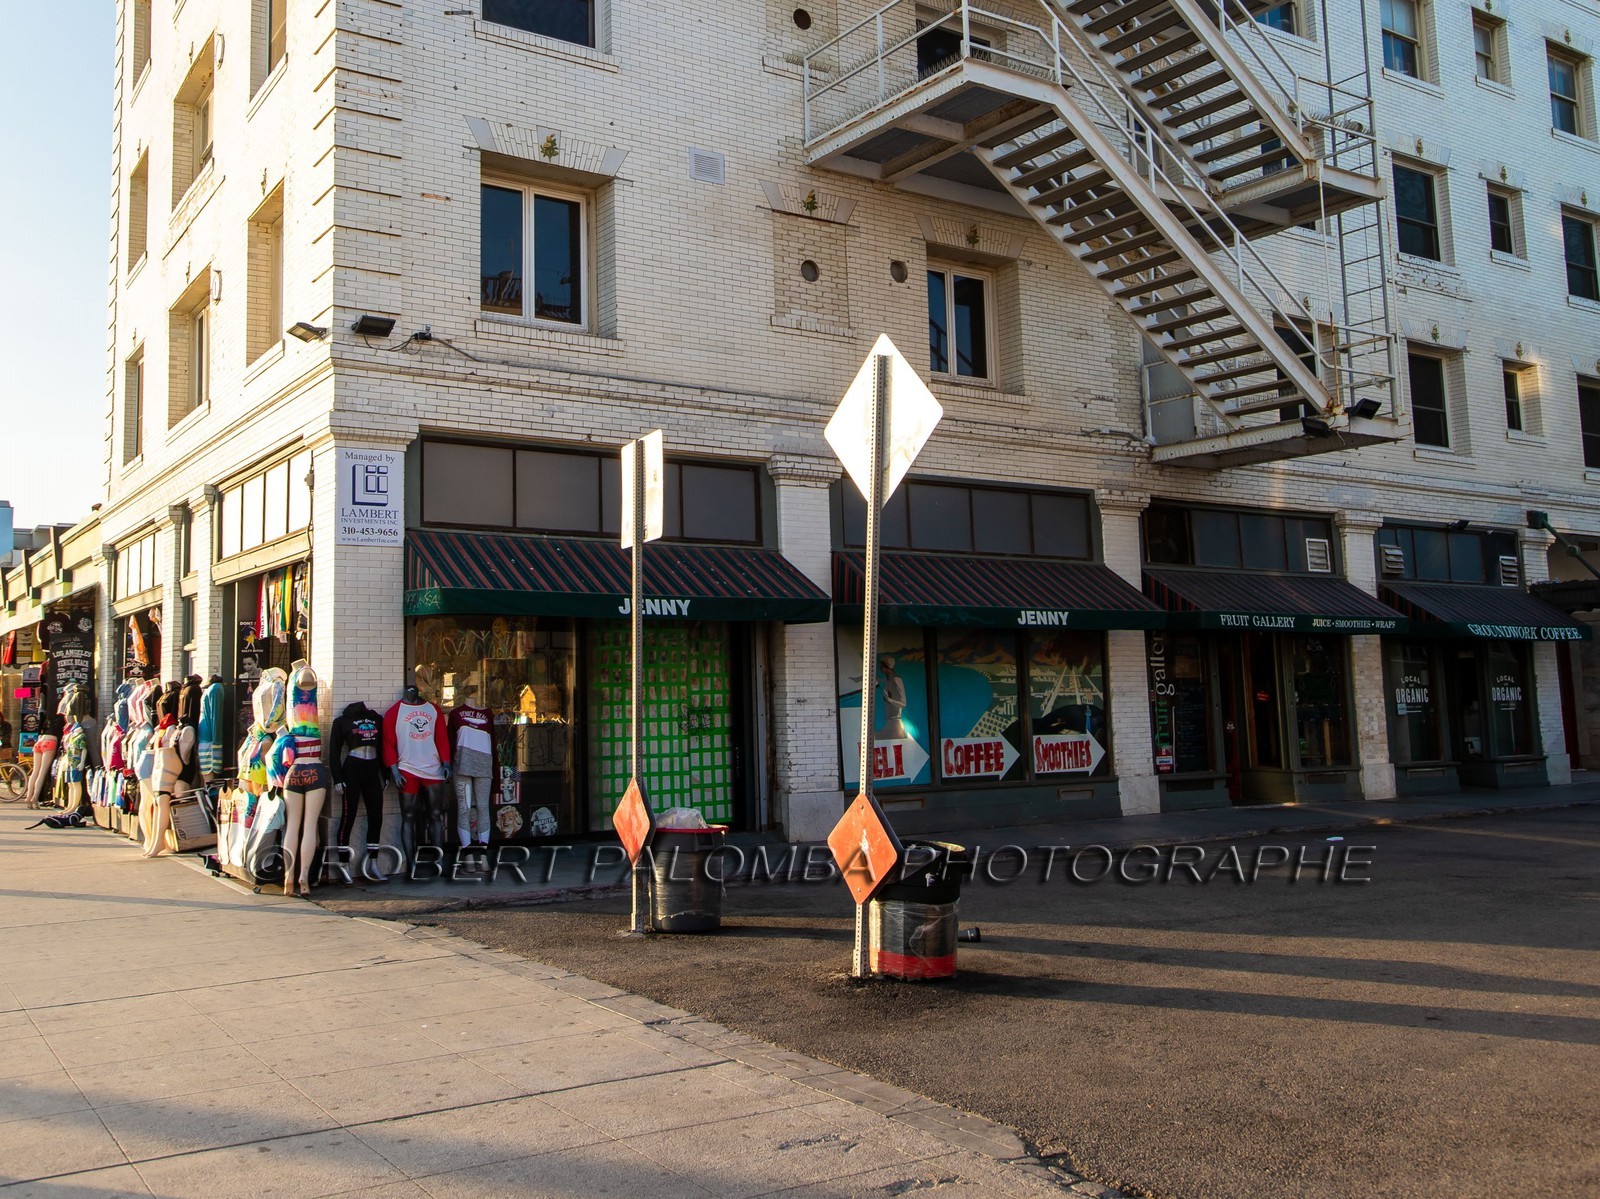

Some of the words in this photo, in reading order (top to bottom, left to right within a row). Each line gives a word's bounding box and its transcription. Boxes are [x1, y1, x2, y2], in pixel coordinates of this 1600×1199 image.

[345, 452, 382, 462] Managed
[385, 454, 395, 464] by
[341, 508, 399, 519] LAMBERT
[342, 527, 398, 536] 310-453-9656
[618, 598, 690, 616] JNNY
[1017, 610, 1069, 626] JENNY
[1220, 614, 1249, 627] FRUIT
[1253, 615, 1296, 628] GALLERY
[1312, 618, 1331, 627] JUICE
[1335, 620, 1371, 628] SMOOTHIES
[1375, 620, 1396, 628] WRAPS
[1467, 623, 1538, 640] GROUNDWORK
[1540, 627, 1582, 640] COFFEE
[65, 649, 92, 658] ANGELES
[1150, 630, 1175, 696] galler
[1400, 675, 1421, 684] LOCAL
[1496, 675, 1515, 683] LOCAL
[1395, 688, 1429, 703] ORGANIC
[1491, 686, 1522, 702] ORGANIC
[857, 742, 904, 778] ELI
[944, 738, 1004, 776] COFFEE
[1034, 737, 1092, 773] SMOOTHIES
